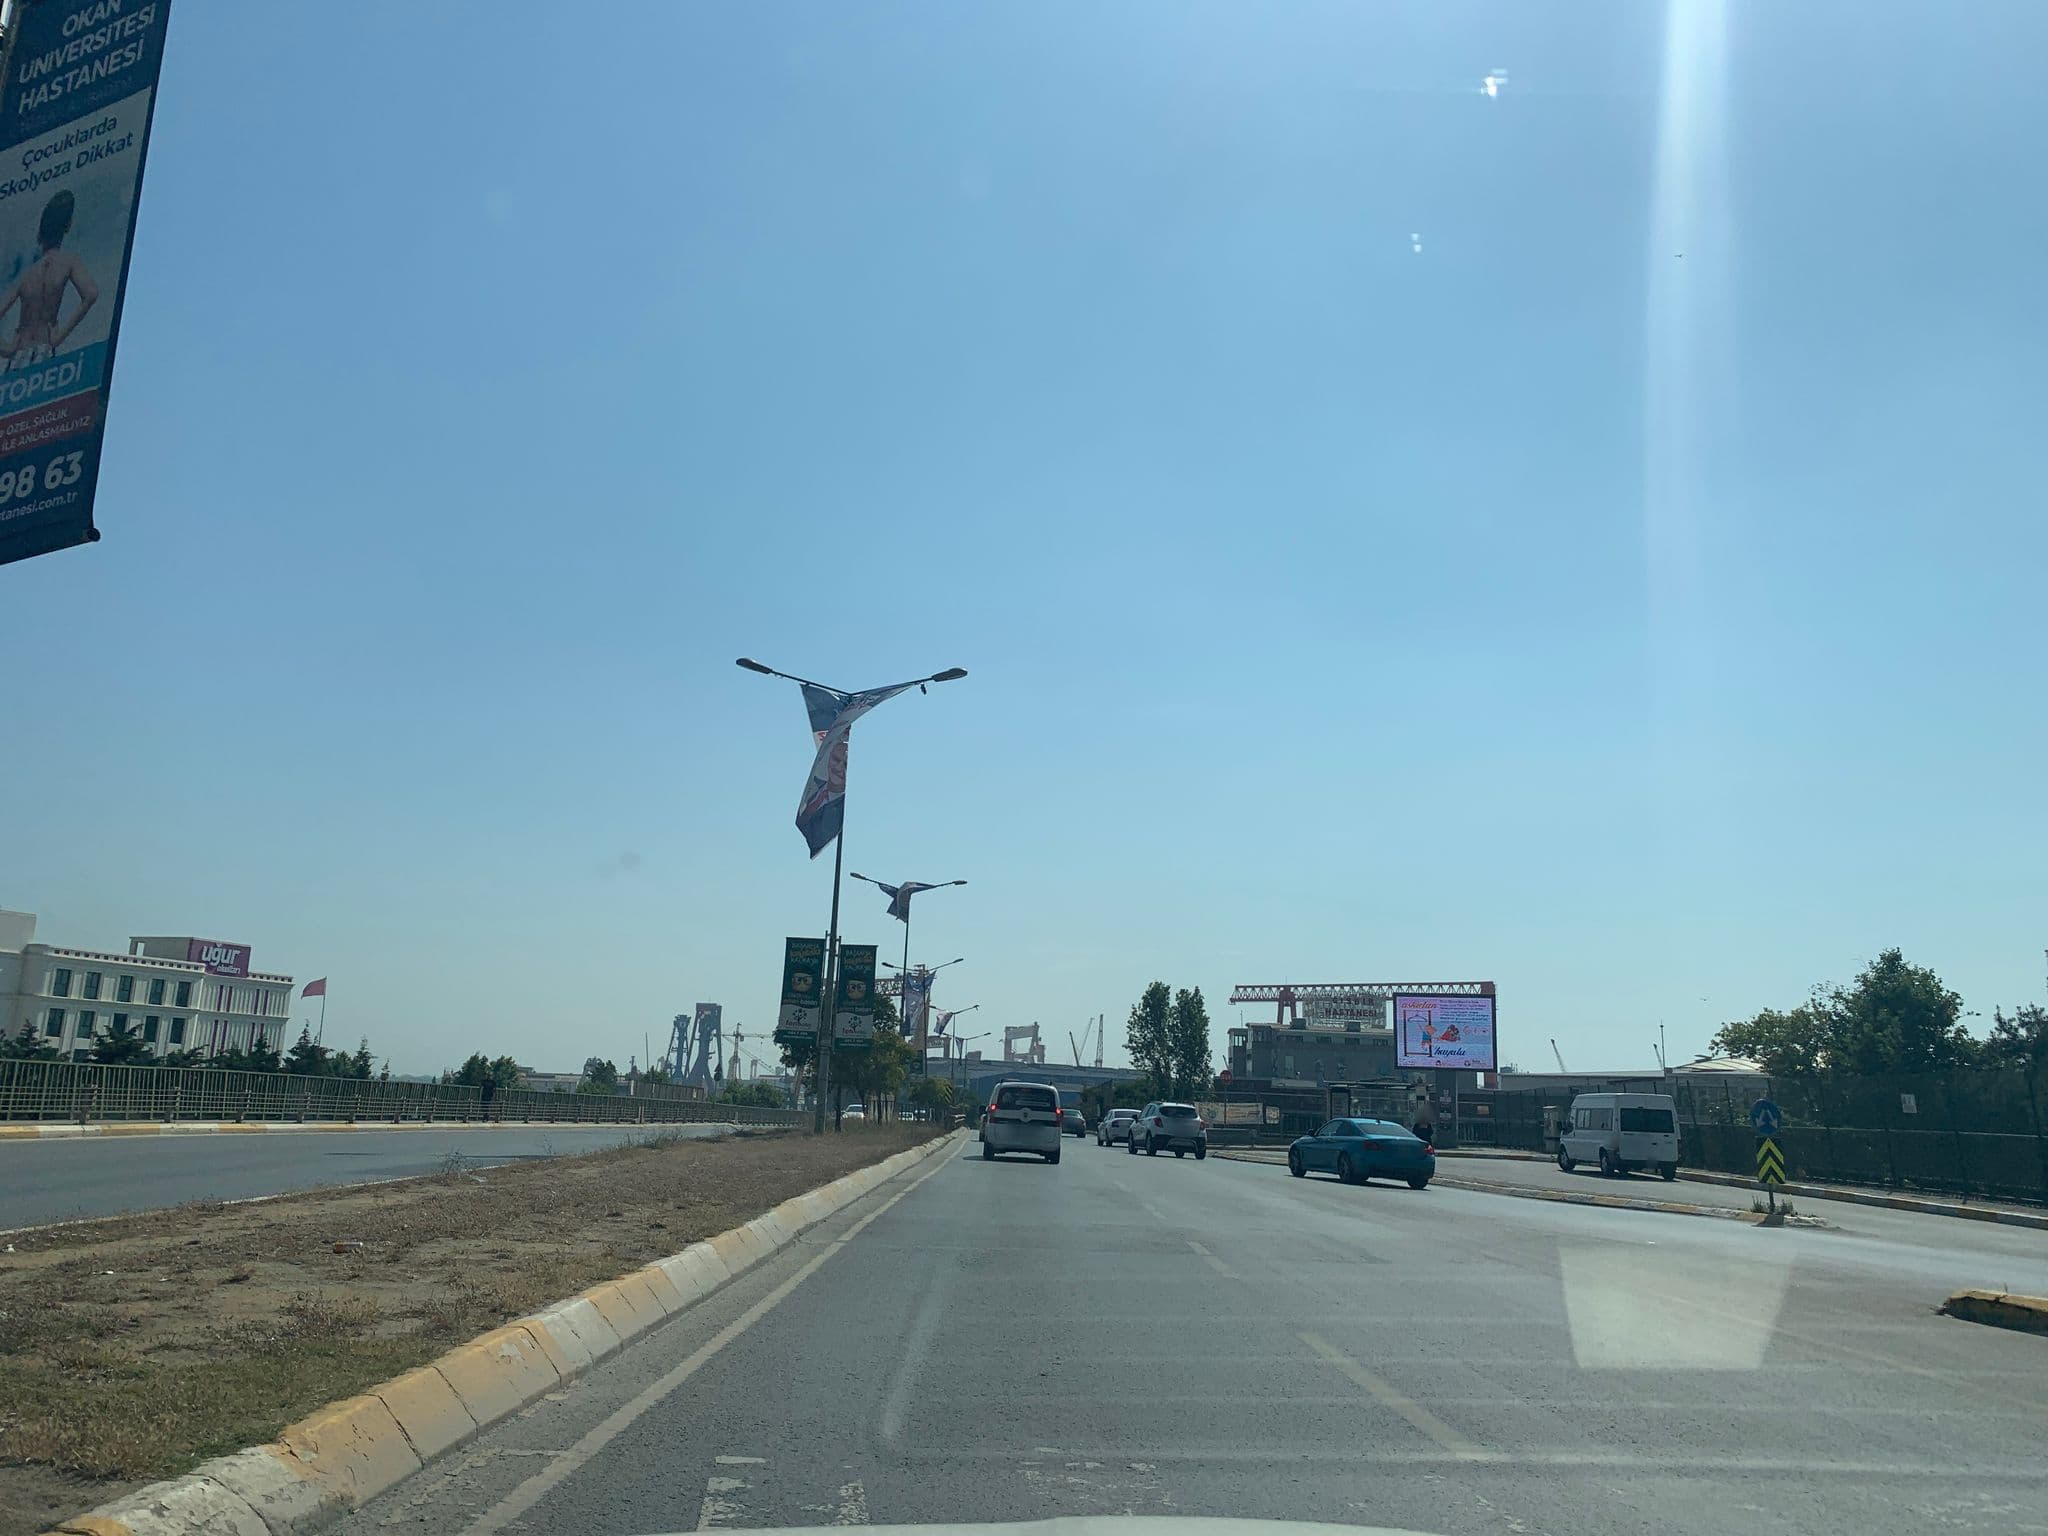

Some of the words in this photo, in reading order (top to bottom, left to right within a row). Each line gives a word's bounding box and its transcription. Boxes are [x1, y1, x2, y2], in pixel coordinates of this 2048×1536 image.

[62, 0, 122, 37] OKAN
[18, 33, 145, 114] HASTANESİ
[21, 115, 117, 171] Çocuklarda
[76, 132, 134, 170] Dikkat
[0, 465, 36, 504] 98
[44, 450, 84, 490] 63
[0, 492, 78, 520] tanesi.com.tr
[202, 943, 240, 966] uğur
